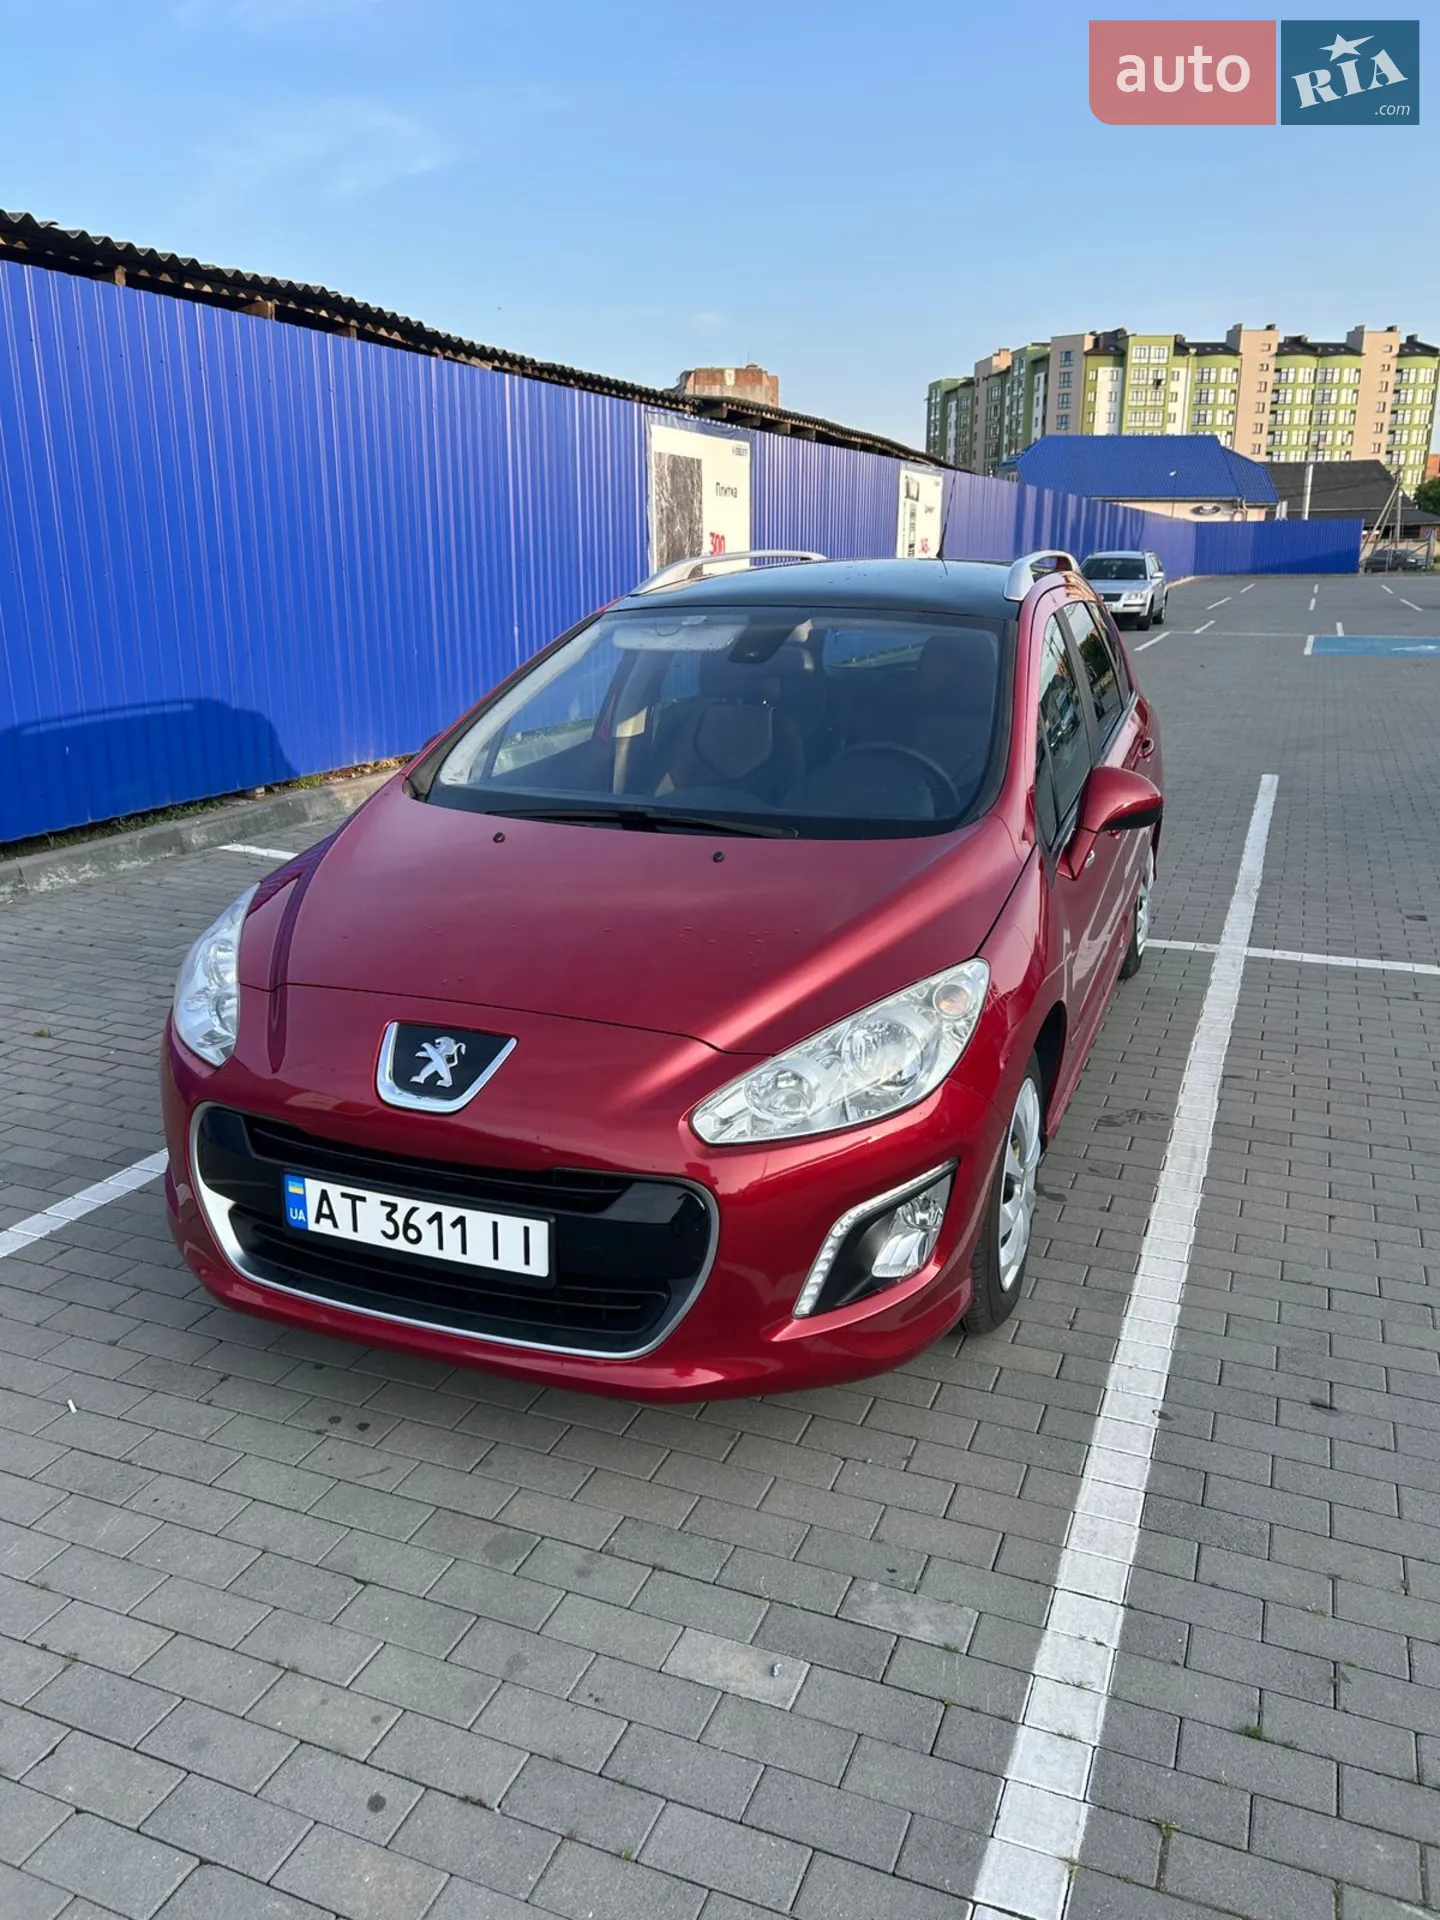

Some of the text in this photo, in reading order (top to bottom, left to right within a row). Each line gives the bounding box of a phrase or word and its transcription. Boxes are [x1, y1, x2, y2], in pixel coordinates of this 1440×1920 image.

[716, 482, 738, 498] Плитка
[290, 1207, 306, 1223] UA
[314, 1189, 367, 1234] AT
[380, 1200, 468, 1256] 3611
